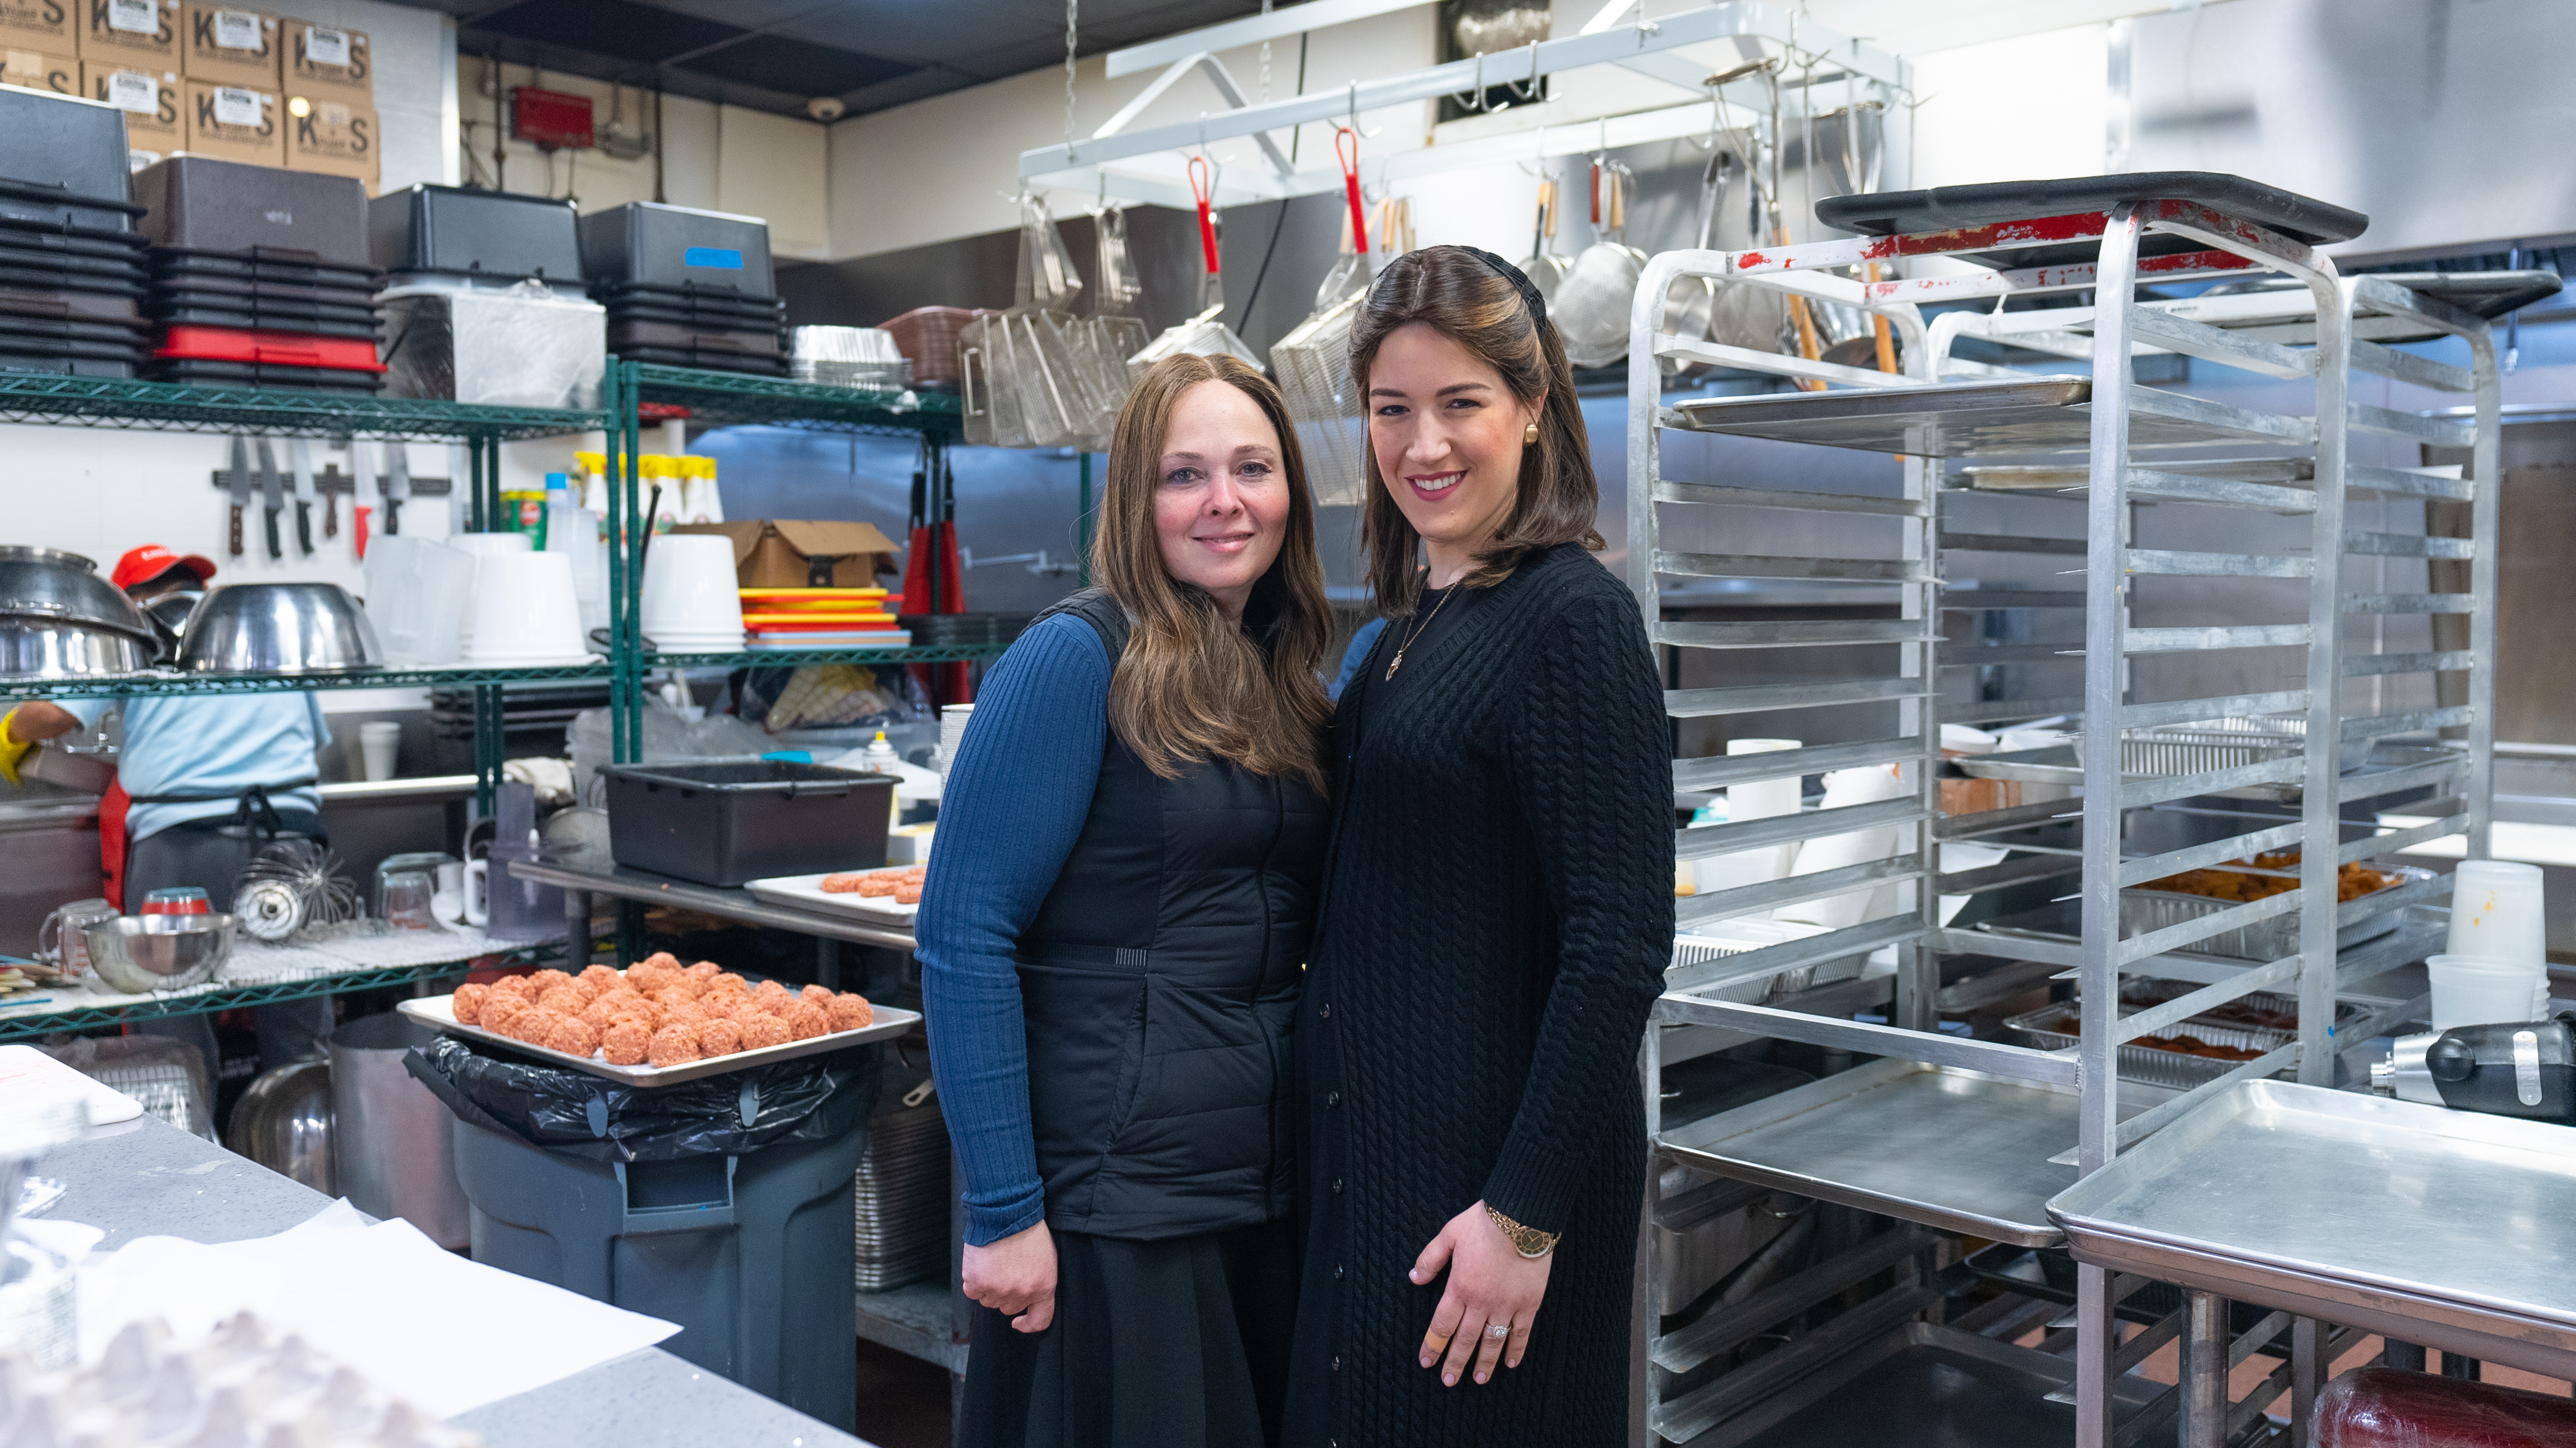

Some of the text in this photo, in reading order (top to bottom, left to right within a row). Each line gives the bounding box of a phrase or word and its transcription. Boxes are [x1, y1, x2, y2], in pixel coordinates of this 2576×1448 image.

[92, 0, 114, 32] K
[151, 6, 173, 44] S
[193, 10, 216, 48] K
[348, 46, 366, 80] S
[157, 87, 176, 124] S
[197, 93, 220, 130] K
[298, 111, 368, 153] K S
